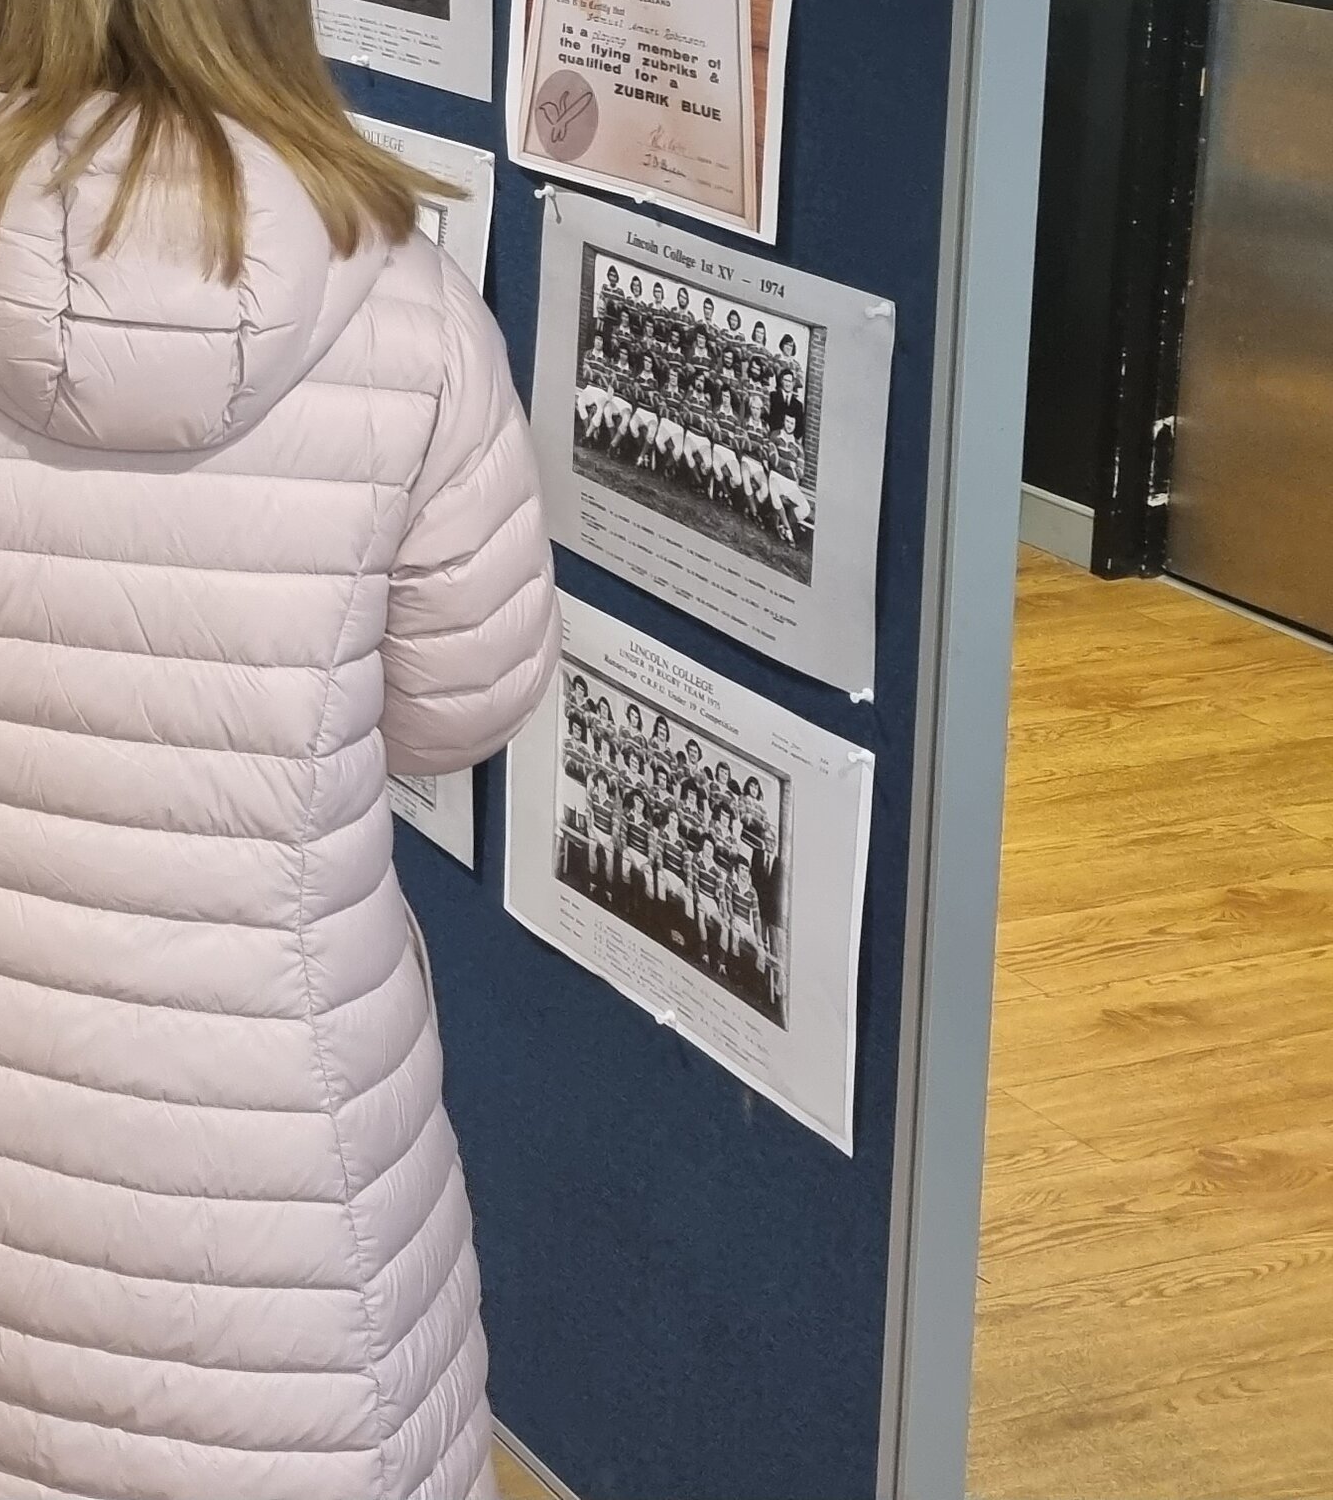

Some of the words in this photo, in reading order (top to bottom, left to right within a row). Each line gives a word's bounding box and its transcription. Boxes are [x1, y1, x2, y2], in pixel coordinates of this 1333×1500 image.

[559, 37, 582, 50] the
[590, 43, 631, 63] flying
[642, 57, 698, 79] zubriks
[709, 72, 721, 84] &
[562, 22, 574, 35] is
[579, 28, 589, 38] a
[637, 42, 699, 64] member
[708, 58, 722, 70] of
[558, 52, 622, 75] qualified
[635, 68, 659, 84] for
[669, 78, 679, 89] a
[613, 83, 670, 108] ZUBRIK
[681, 100, 722, 122] BLUE
[361, 128, 406, 153] OLLEGE
[626, 231, 659, 255] Lincoln
[663, 245, 697, 269] College
[700, 258, 714, 275] 1st
[717, 264, 735, 281] XV
[759, 278, 786, 298] 1974
[630, 640, 670, 669] LINCOLN
[672, 664, 715, 695] COLLEGE
